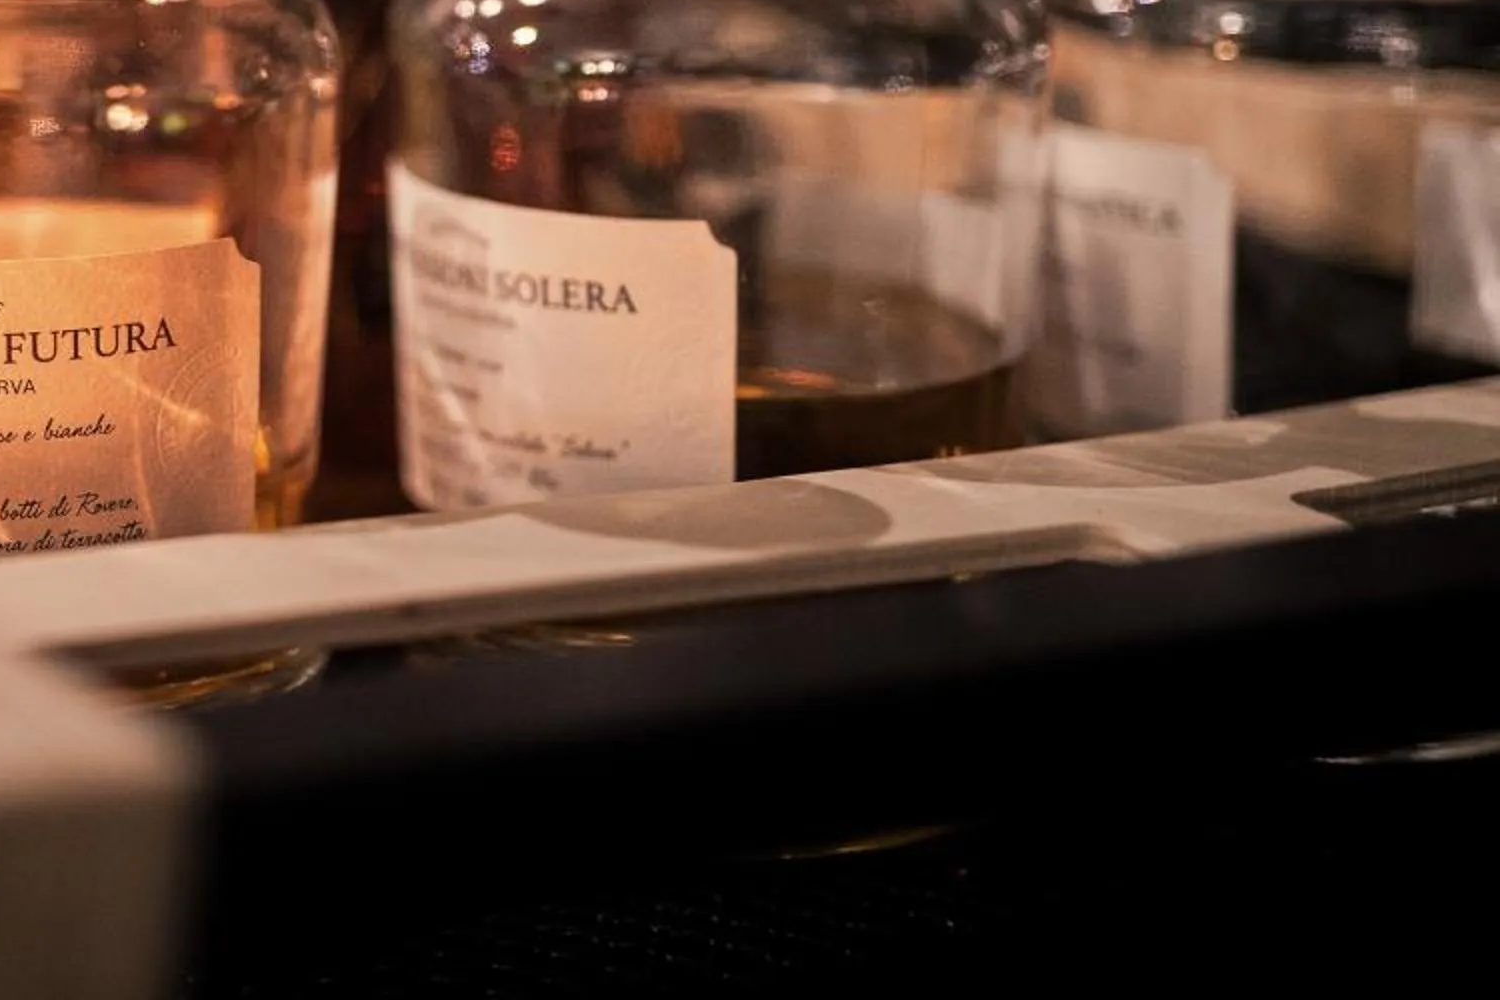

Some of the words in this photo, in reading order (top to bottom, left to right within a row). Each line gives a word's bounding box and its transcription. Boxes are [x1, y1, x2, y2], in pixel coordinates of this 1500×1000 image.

[494, 269, 639, 316] SOLERA
[3, 317, 178, 366] FUTURA
[23, 430, 36, 443] e
[43, 414, 116, 442] bianche
[0, 498, 45, 521] botti
[48, 495, 71, 518] di
[33, 529, 55, 551] di
[61, 520, 149, 550] terracotta
